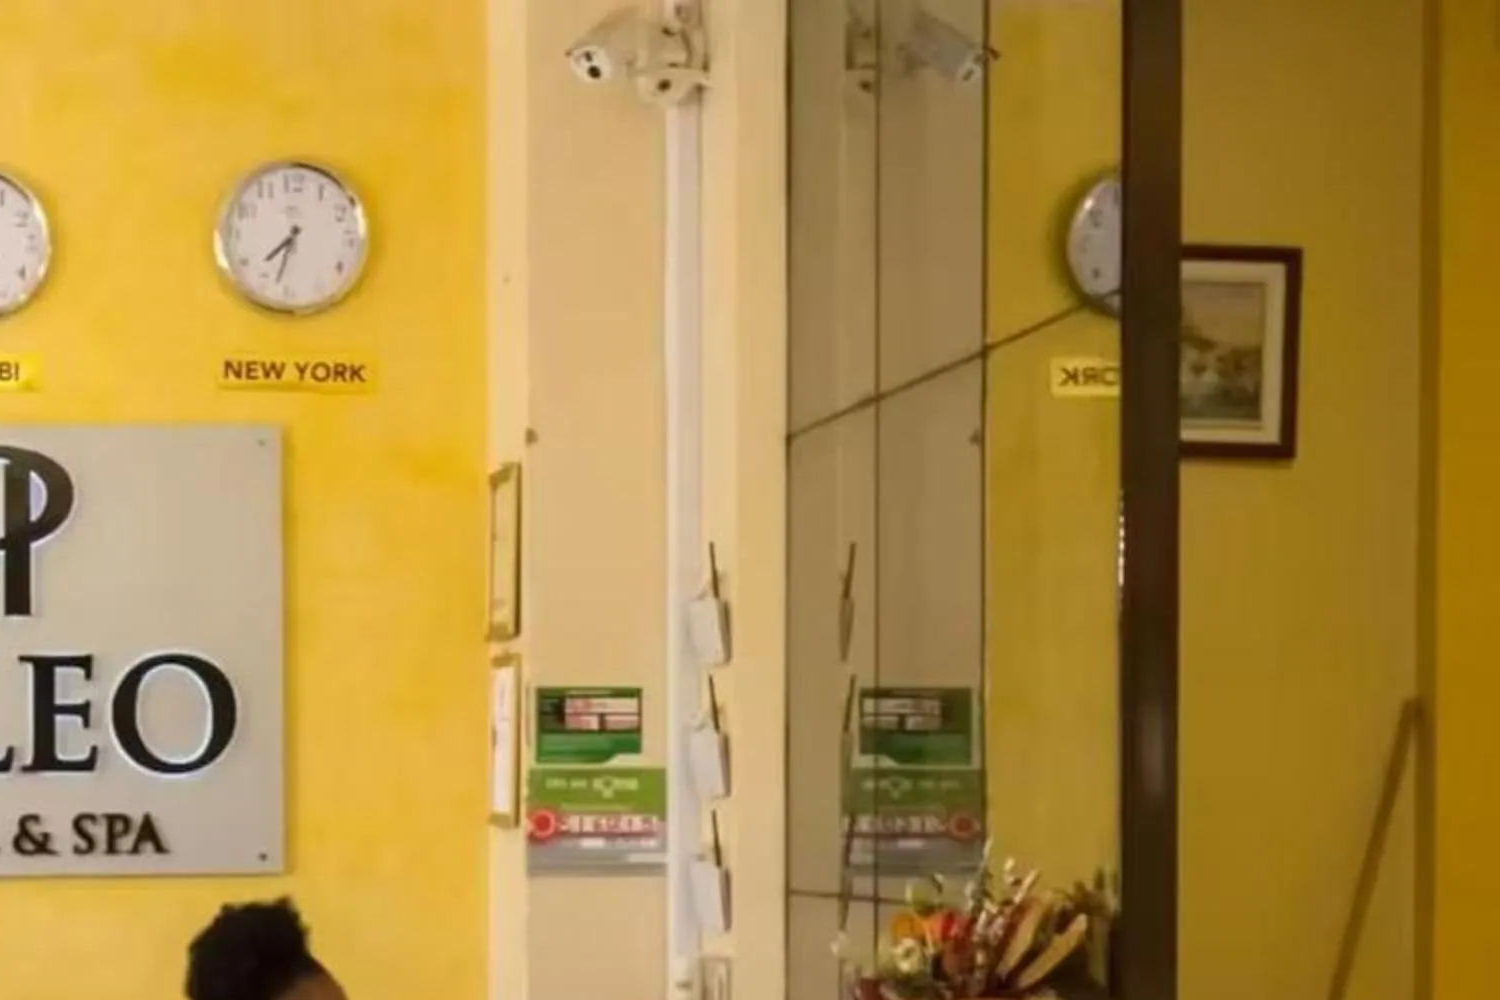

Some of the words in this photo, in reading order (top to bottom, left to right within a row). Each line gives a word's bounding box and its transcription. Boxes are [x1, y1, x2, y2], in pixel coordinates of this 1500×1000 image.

[223, 360, 286, 380] NEW
[294, 361, 367, 383] YORK
[12, 814, 57, 857] &
[72, 813, 169, 857] SPA
